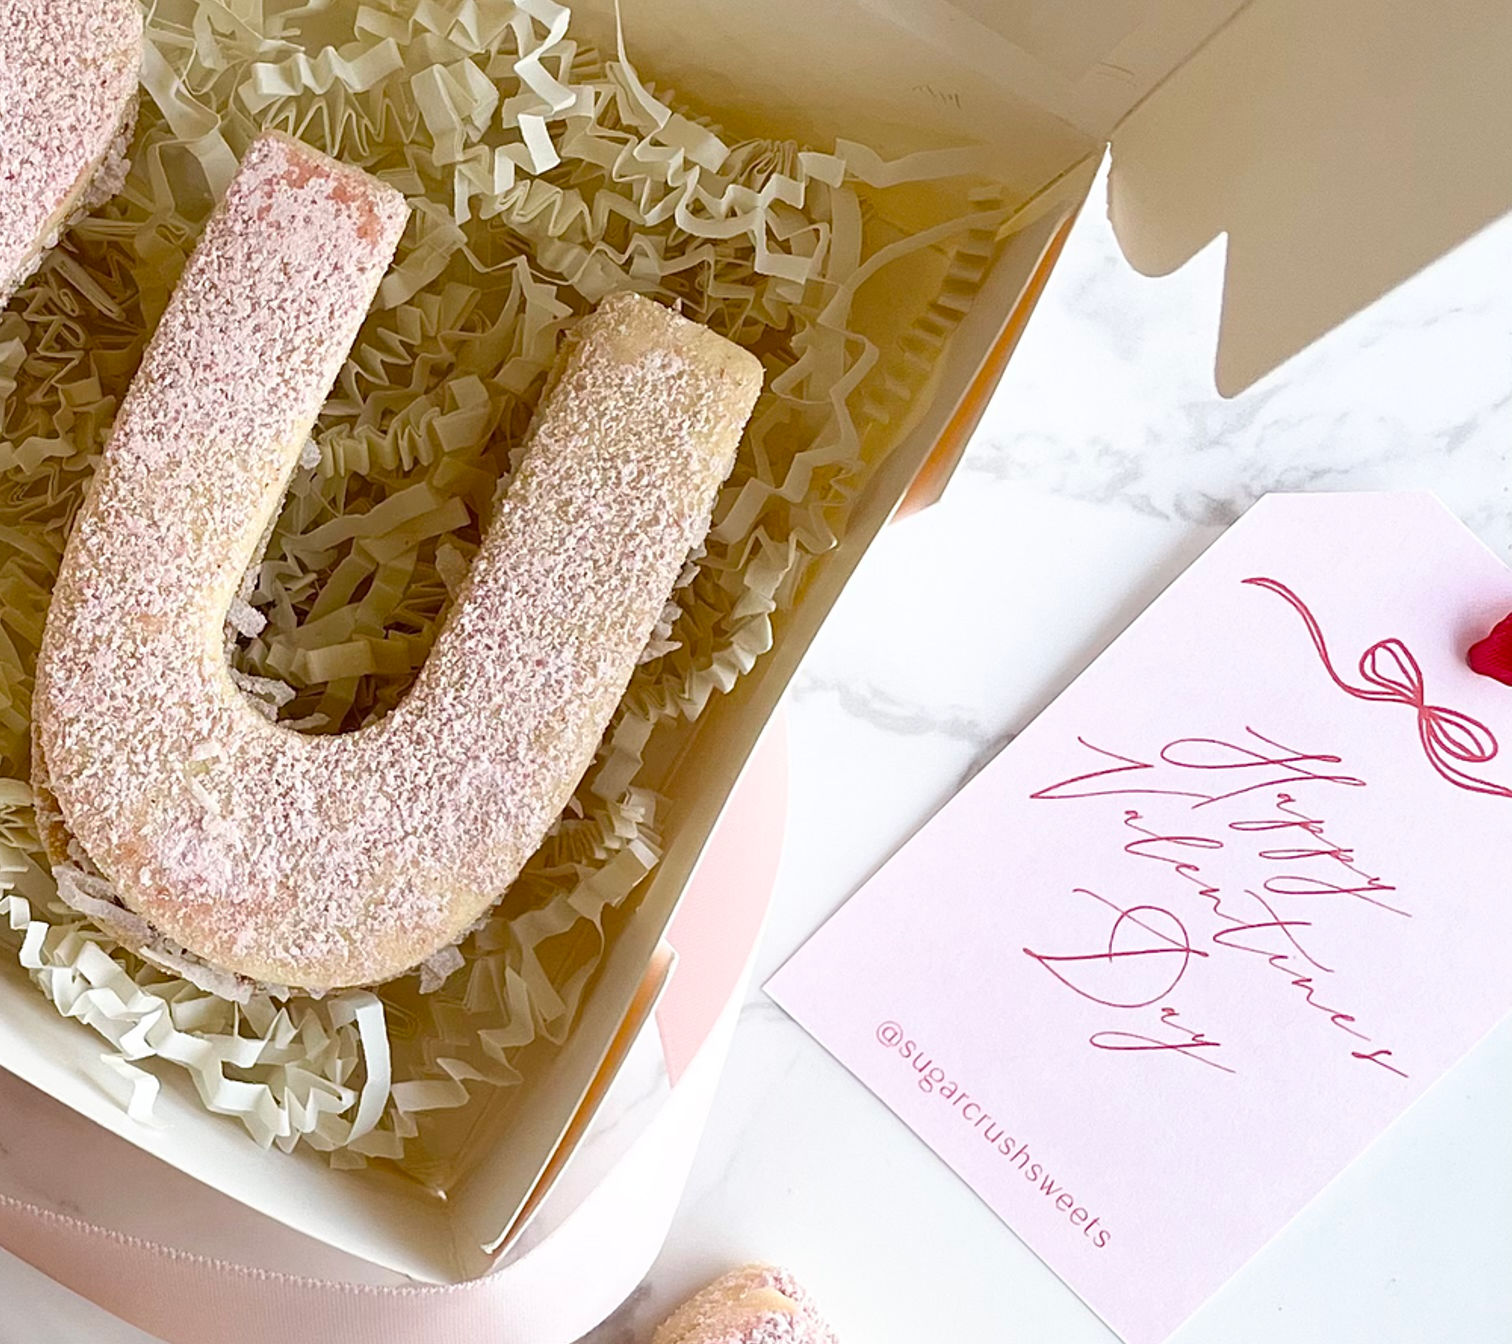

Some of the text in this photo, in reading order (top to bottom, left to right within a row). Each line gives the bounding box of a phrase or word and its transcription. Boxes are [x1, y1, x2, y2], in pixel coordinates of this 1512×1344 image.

[36, 130, 763, 991] U
[1029, 736, 1409, 1078] Valentines
[1159, 725, 1412, 917] Happy
[1023, 888, 1236, 1074] Day
[875, 1019, 1112, 1250] @sugarcrushsweets
